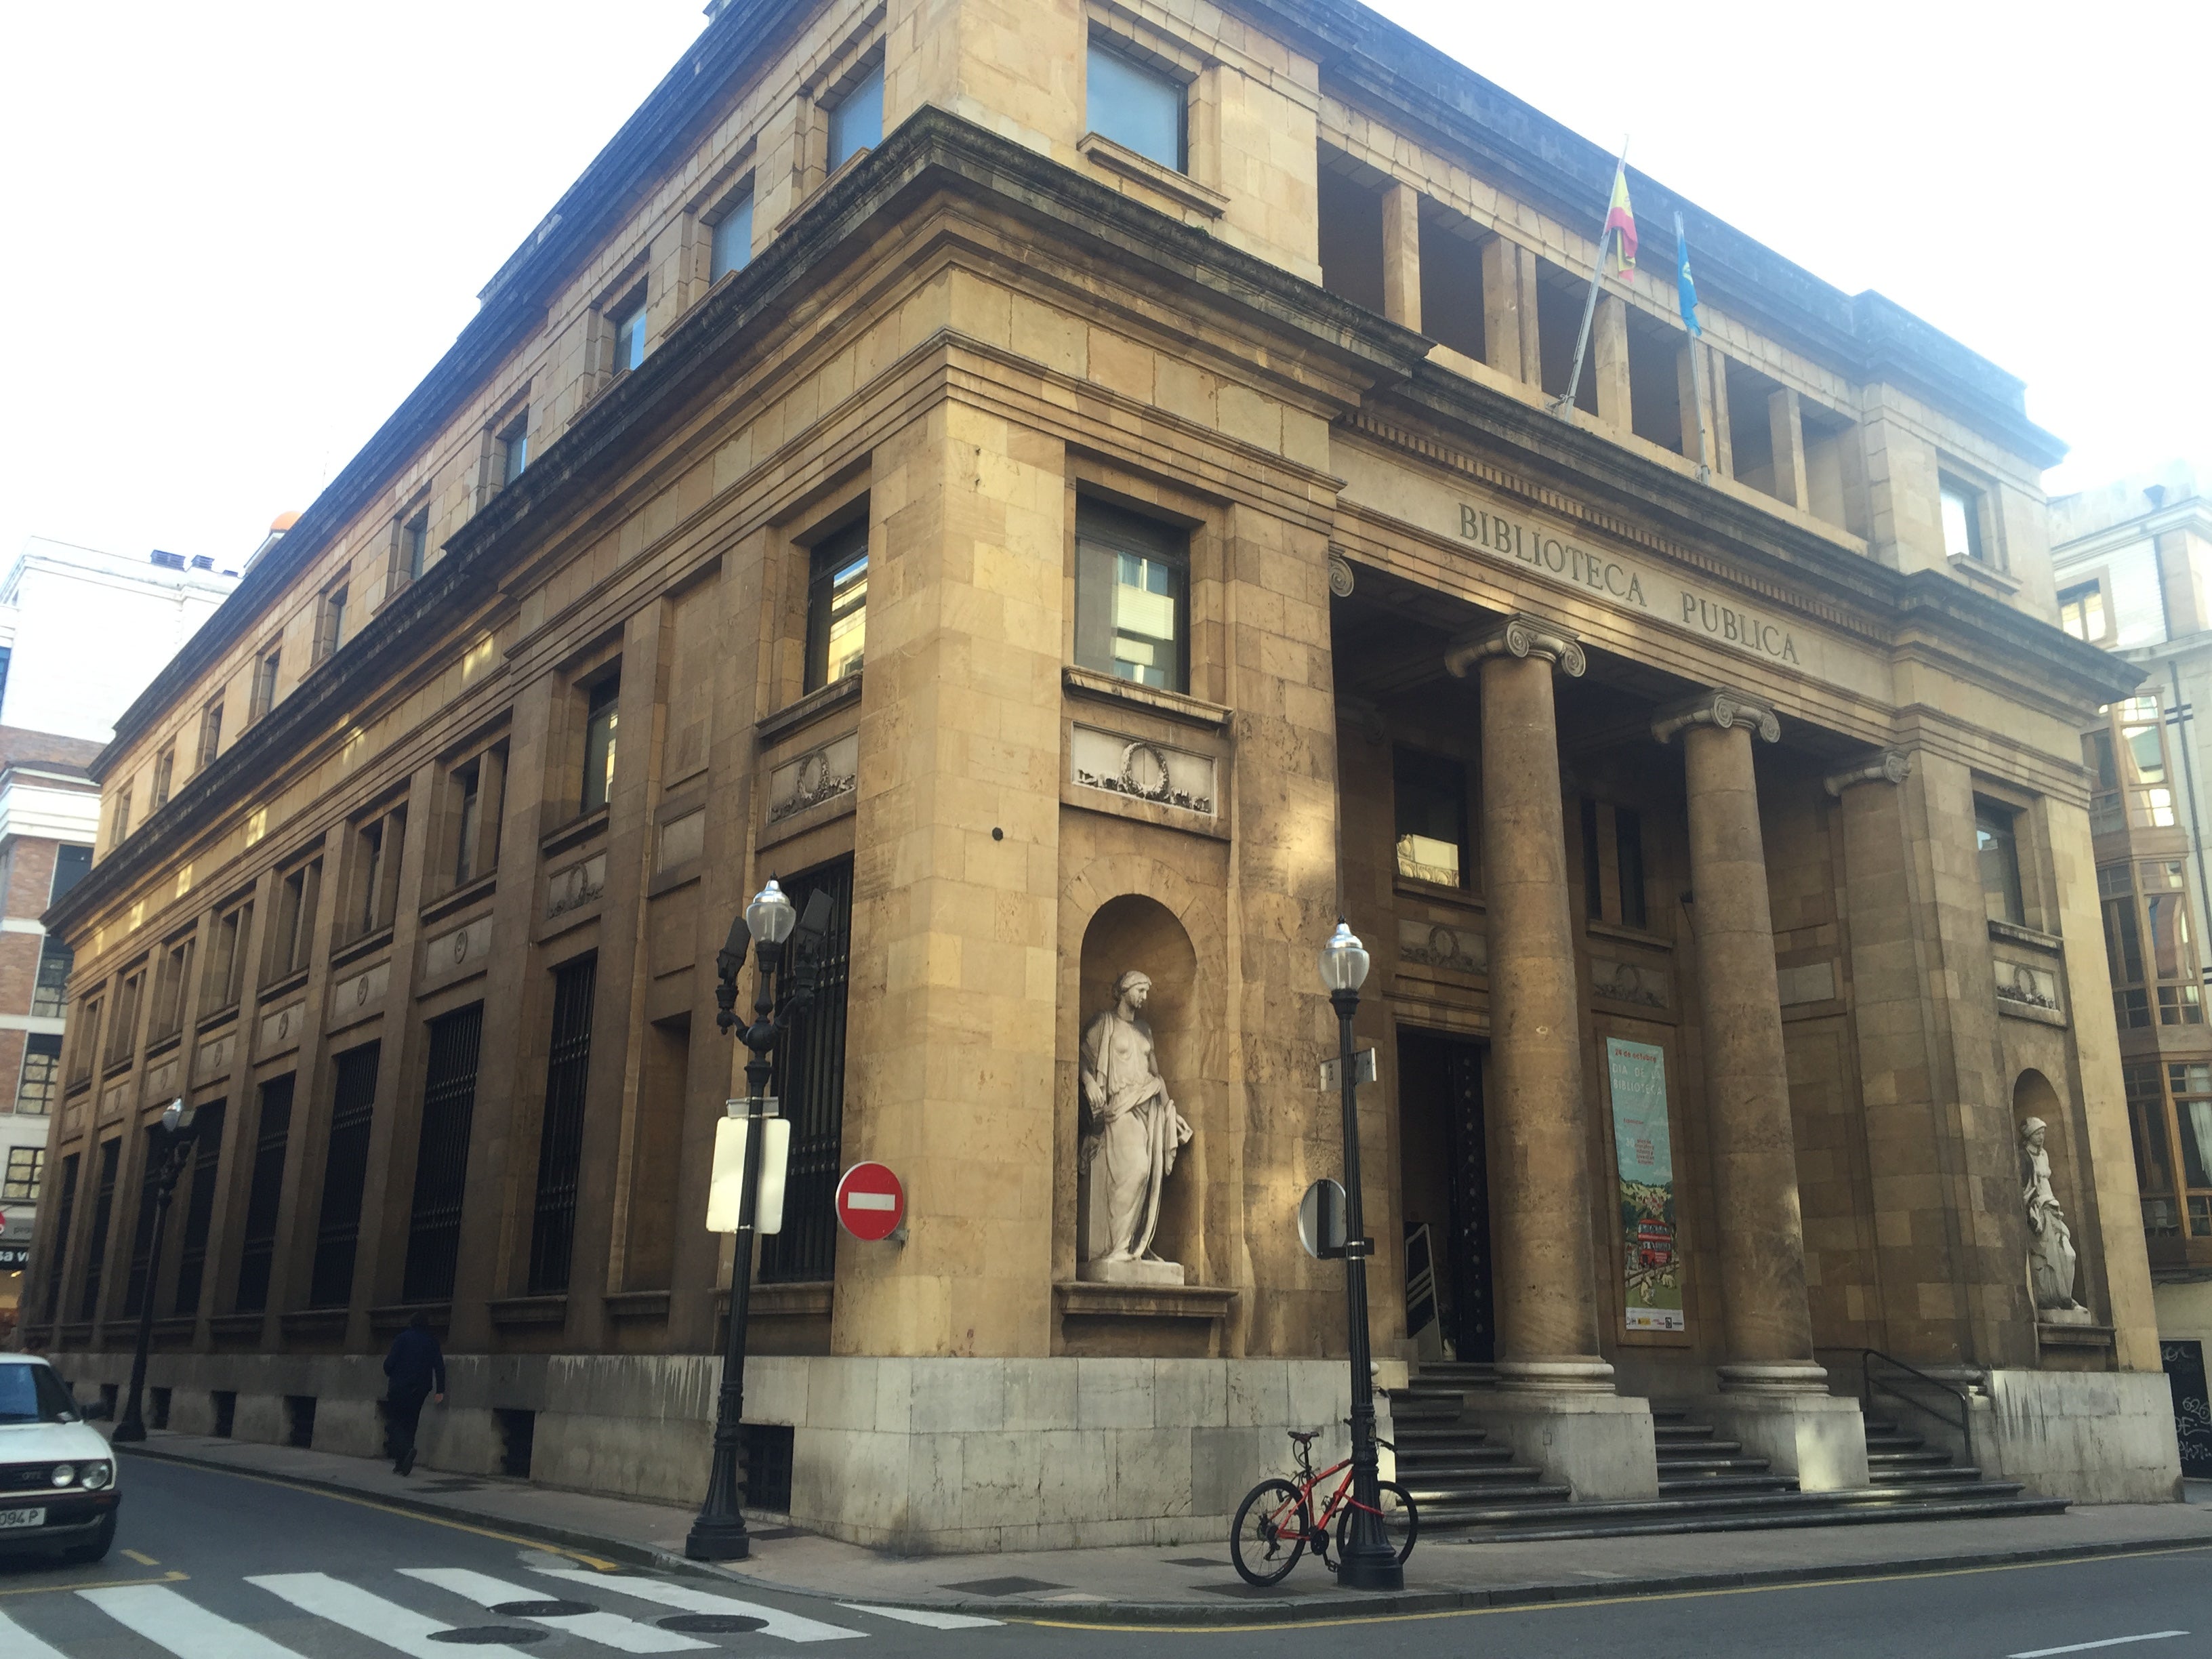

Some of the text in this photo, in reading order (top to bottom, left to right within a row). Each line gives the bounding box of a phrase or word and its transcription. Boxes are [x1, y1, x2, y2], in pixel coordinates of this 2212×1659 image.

[1458, 502, 1800, 665] BIBLIOTECA PUBLICA
[1635, 1067, 1645, 1078] DE
[1613, 1078, 1662, 1096] BIBLIOTECA
